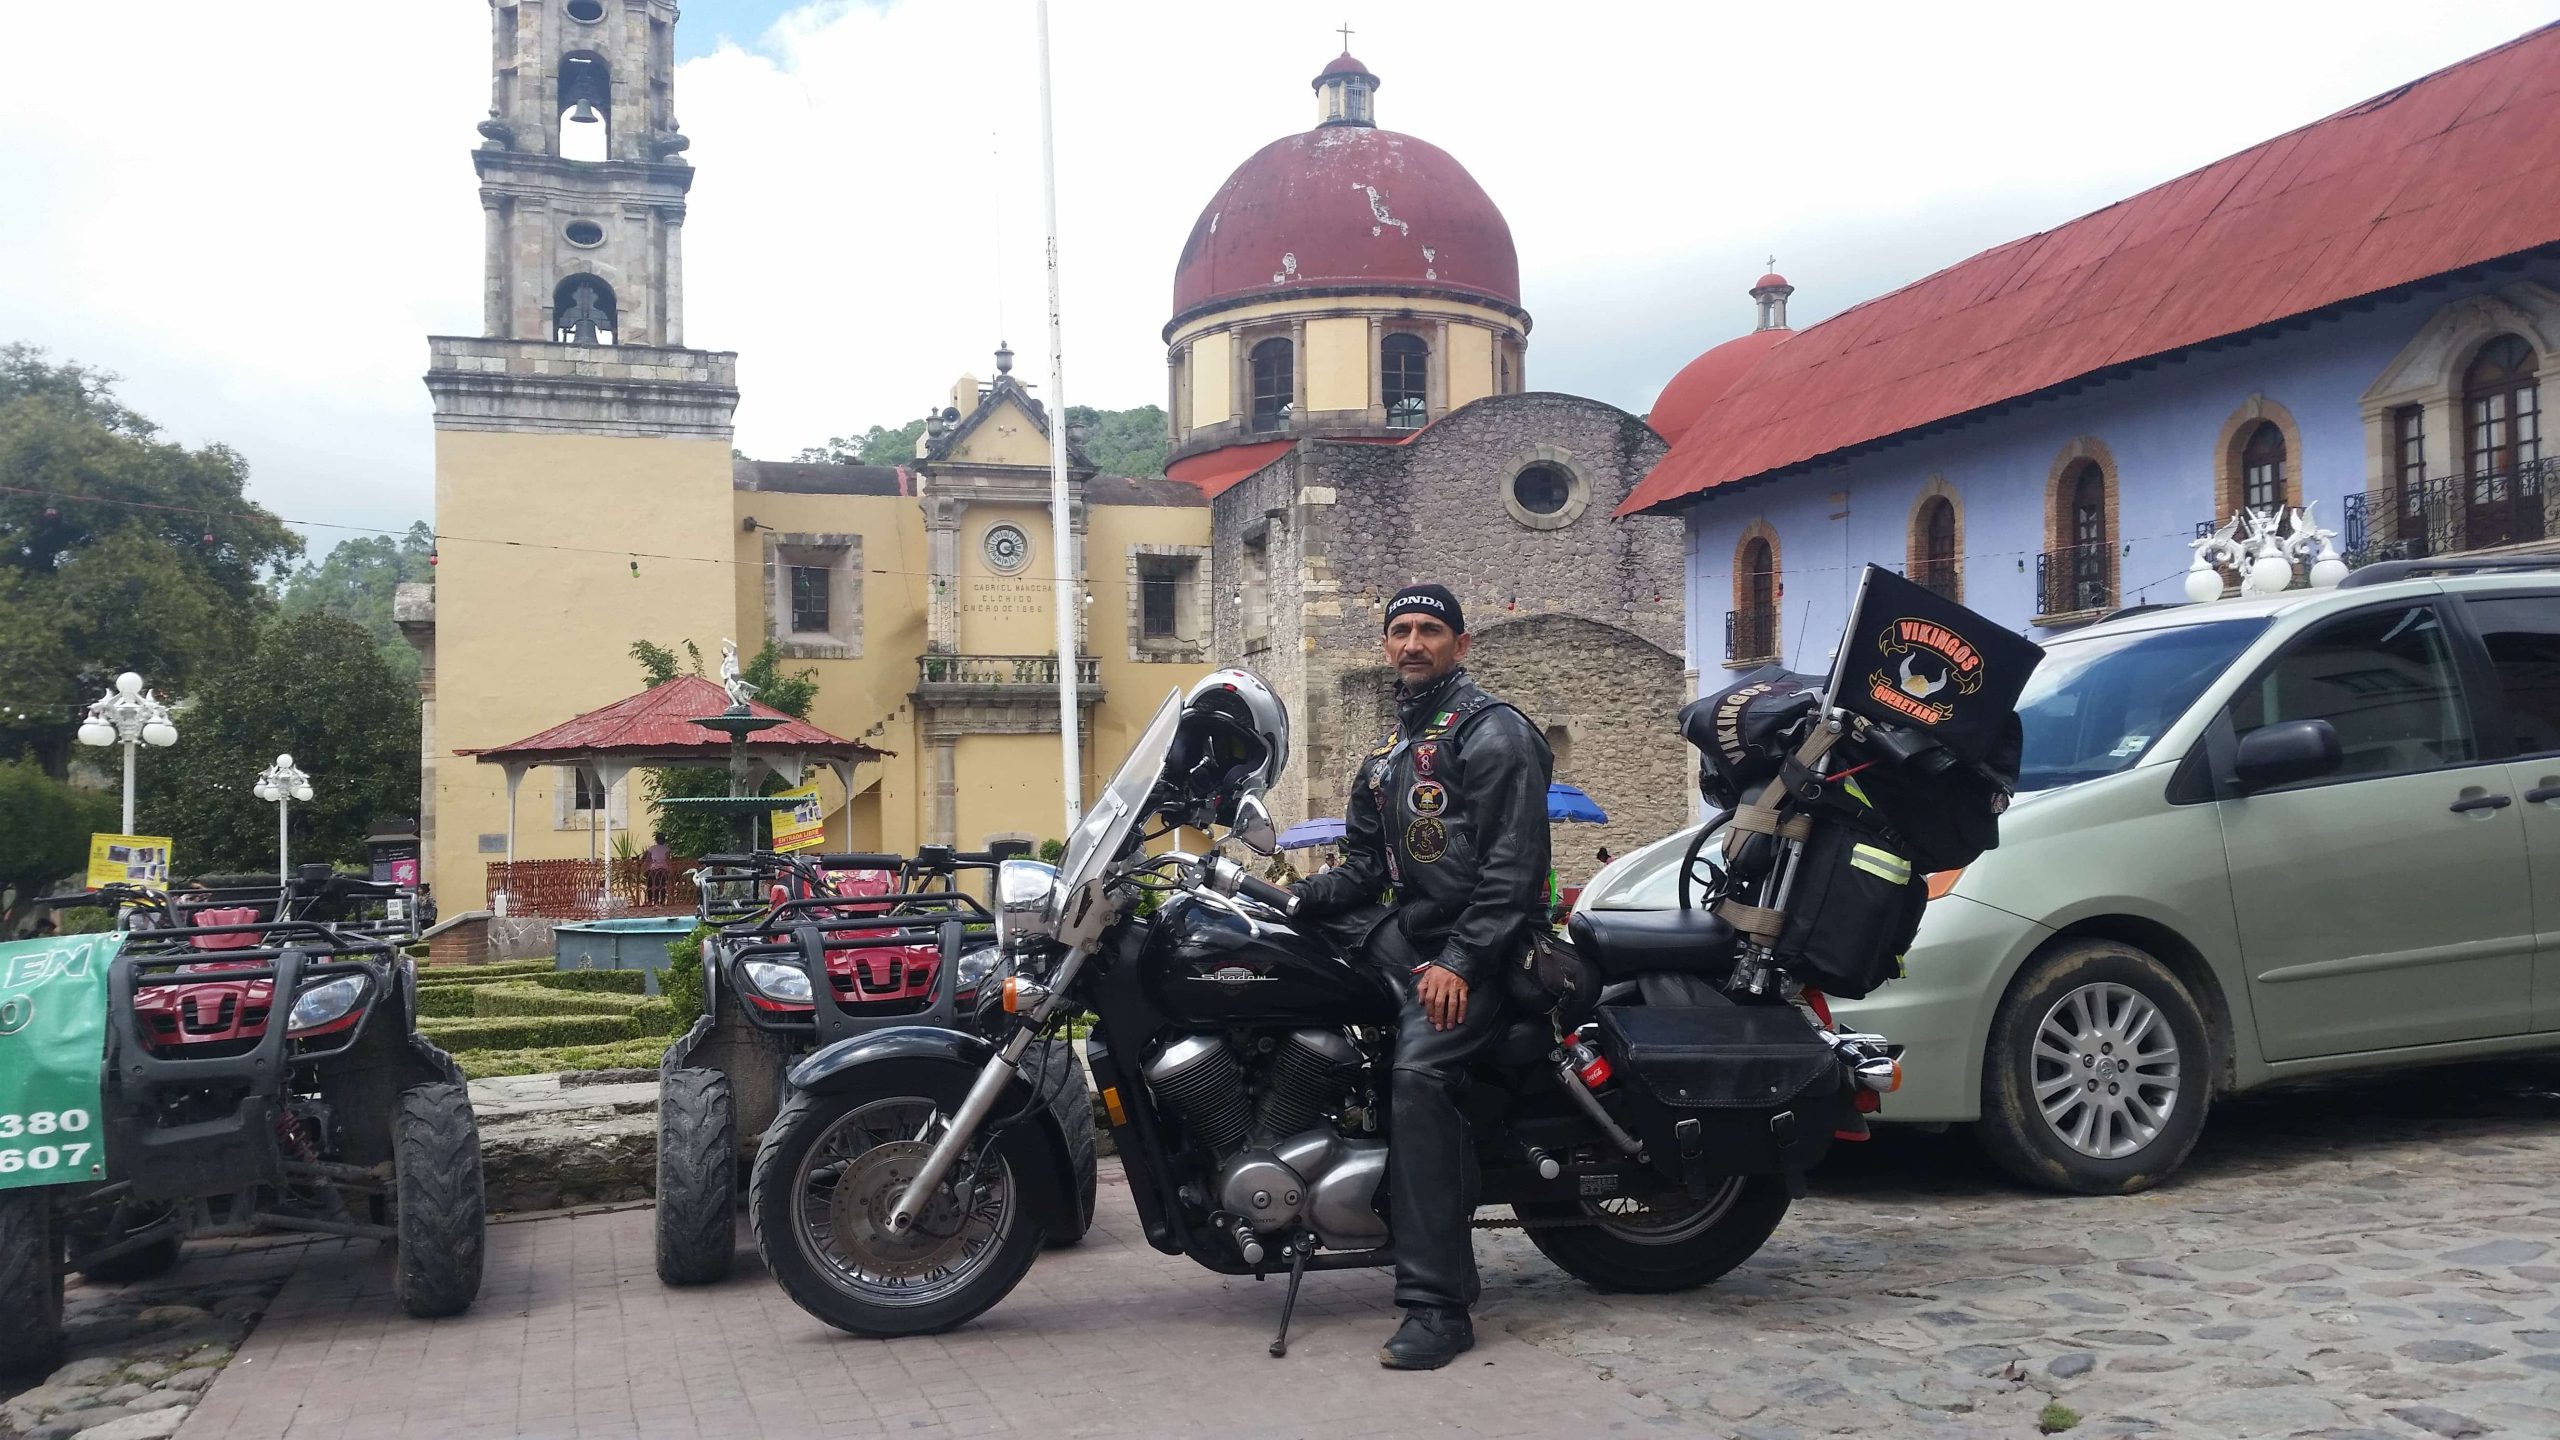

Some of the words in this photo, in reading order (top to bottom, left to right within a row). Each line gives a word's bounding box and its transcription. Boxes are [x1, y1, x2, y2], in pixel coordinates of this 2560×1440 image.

[974, 584, 1012, 592] GABRIEL
[1388, 595, 1445, 614] HONDA
[1901, 621, 1979, 672] VIKINGOS
[1873, 685, 1940, 723] QUERETARO
[1716, 684, 1772, 766] VIKINGOS
[778, 831, 803, 844] ENTRADA
[803, 828, 819, 838] LIBRE
[4, 942, 92, 988] EN
[1200, 967, 1268, 981] Shadow
[0, 1109, 90, 1138] 380
[0, 1143, 91, 1172] 607
